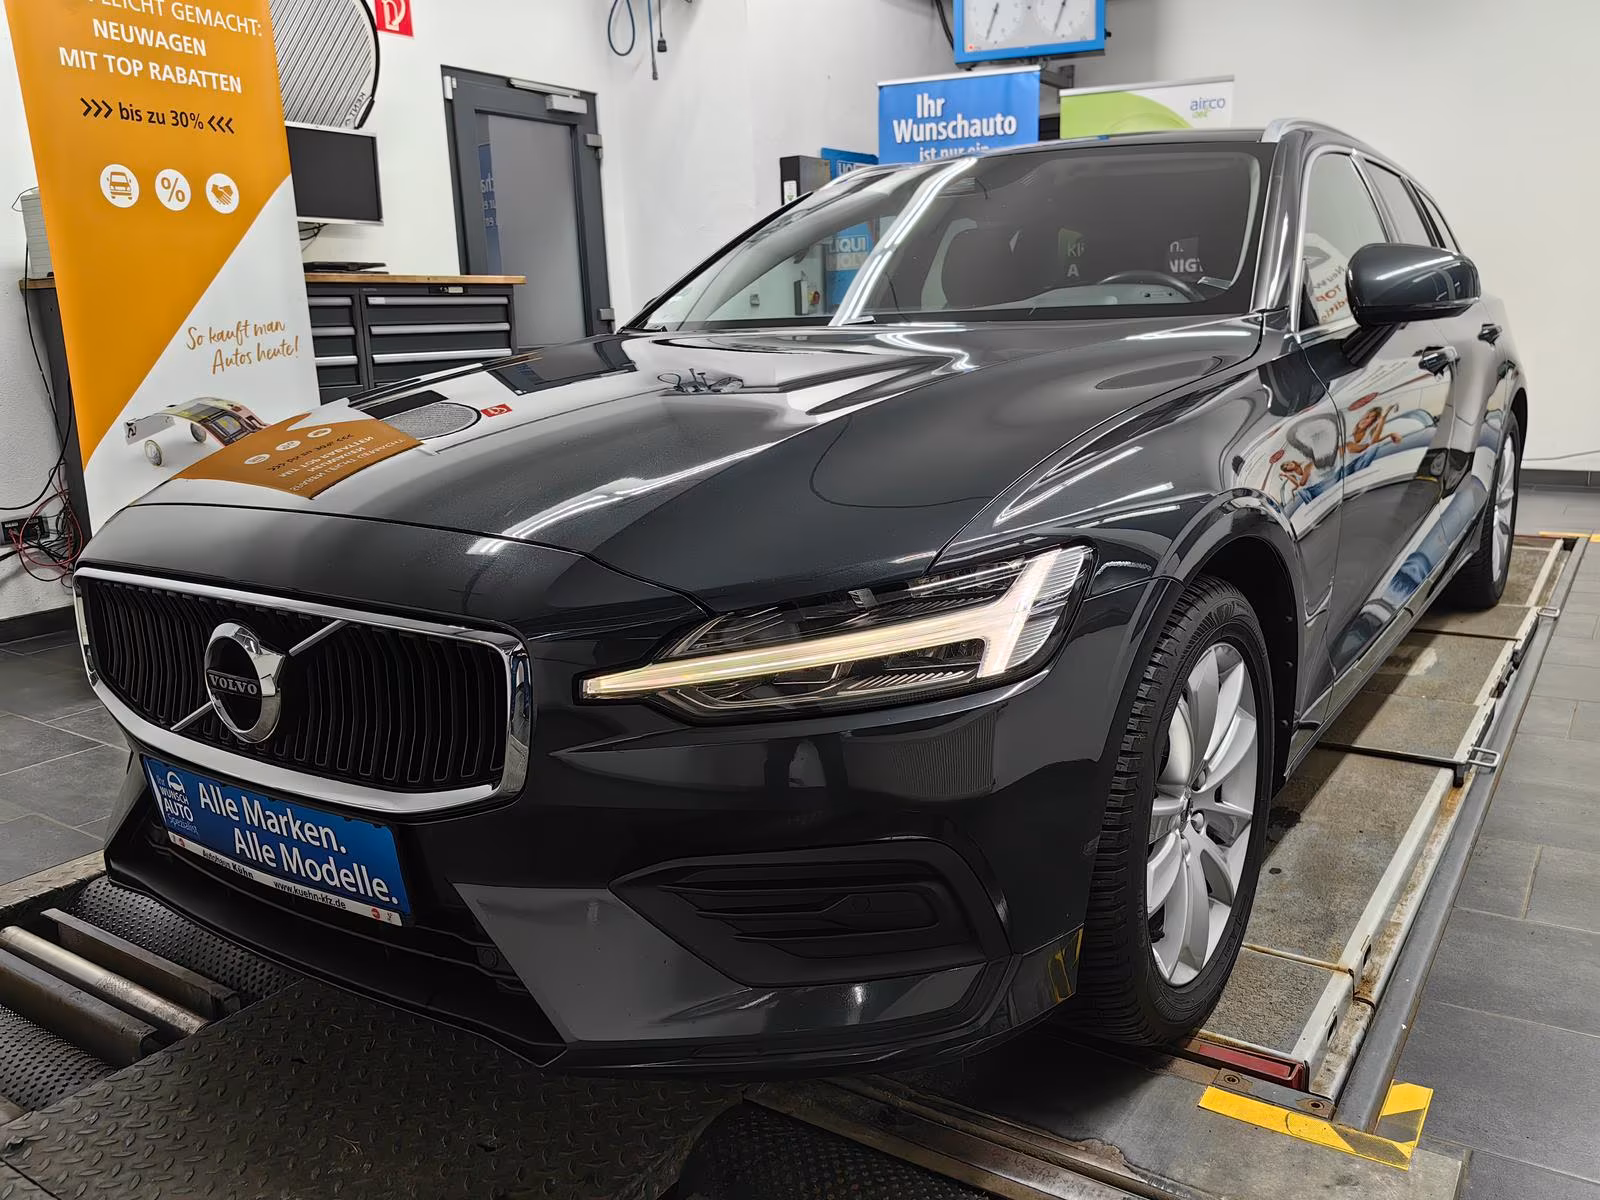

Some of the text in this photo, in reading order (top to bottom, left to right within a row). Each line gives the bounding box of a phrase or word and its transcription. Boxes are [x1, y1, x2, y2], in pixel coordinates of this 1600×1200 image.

[171, 2, 262, 37] GEMACHT:
[92, 18, 207, 57] NEUWAGEN
[58, 47, 242, 94] MIT TOP RABATTEN
[118, 101, 204, 130] bis zu 30%
[916, 93, 946, 119] Ihr
[1190, 97, 1226, 112] airco
[892, 112, 1018, 144] Wunschauto
[920, 147, 938, 161] ist
[187, 319, 285, 350] So kauft man
[212, 335, 299, 375] Autos heute!
[209, 674, 258, 695] VOLVO
[159, 785, 190, 806] WUNSCH
[163, 797, 194, 823] AUTO
[199, 782, 347, 854] Alle Marken.
[231, 860, 255, 879] Kühn
[234, 828, 399, 905] Alle Modelle.
[273, 880, 347, 909] www.kuehn-kfz.de
